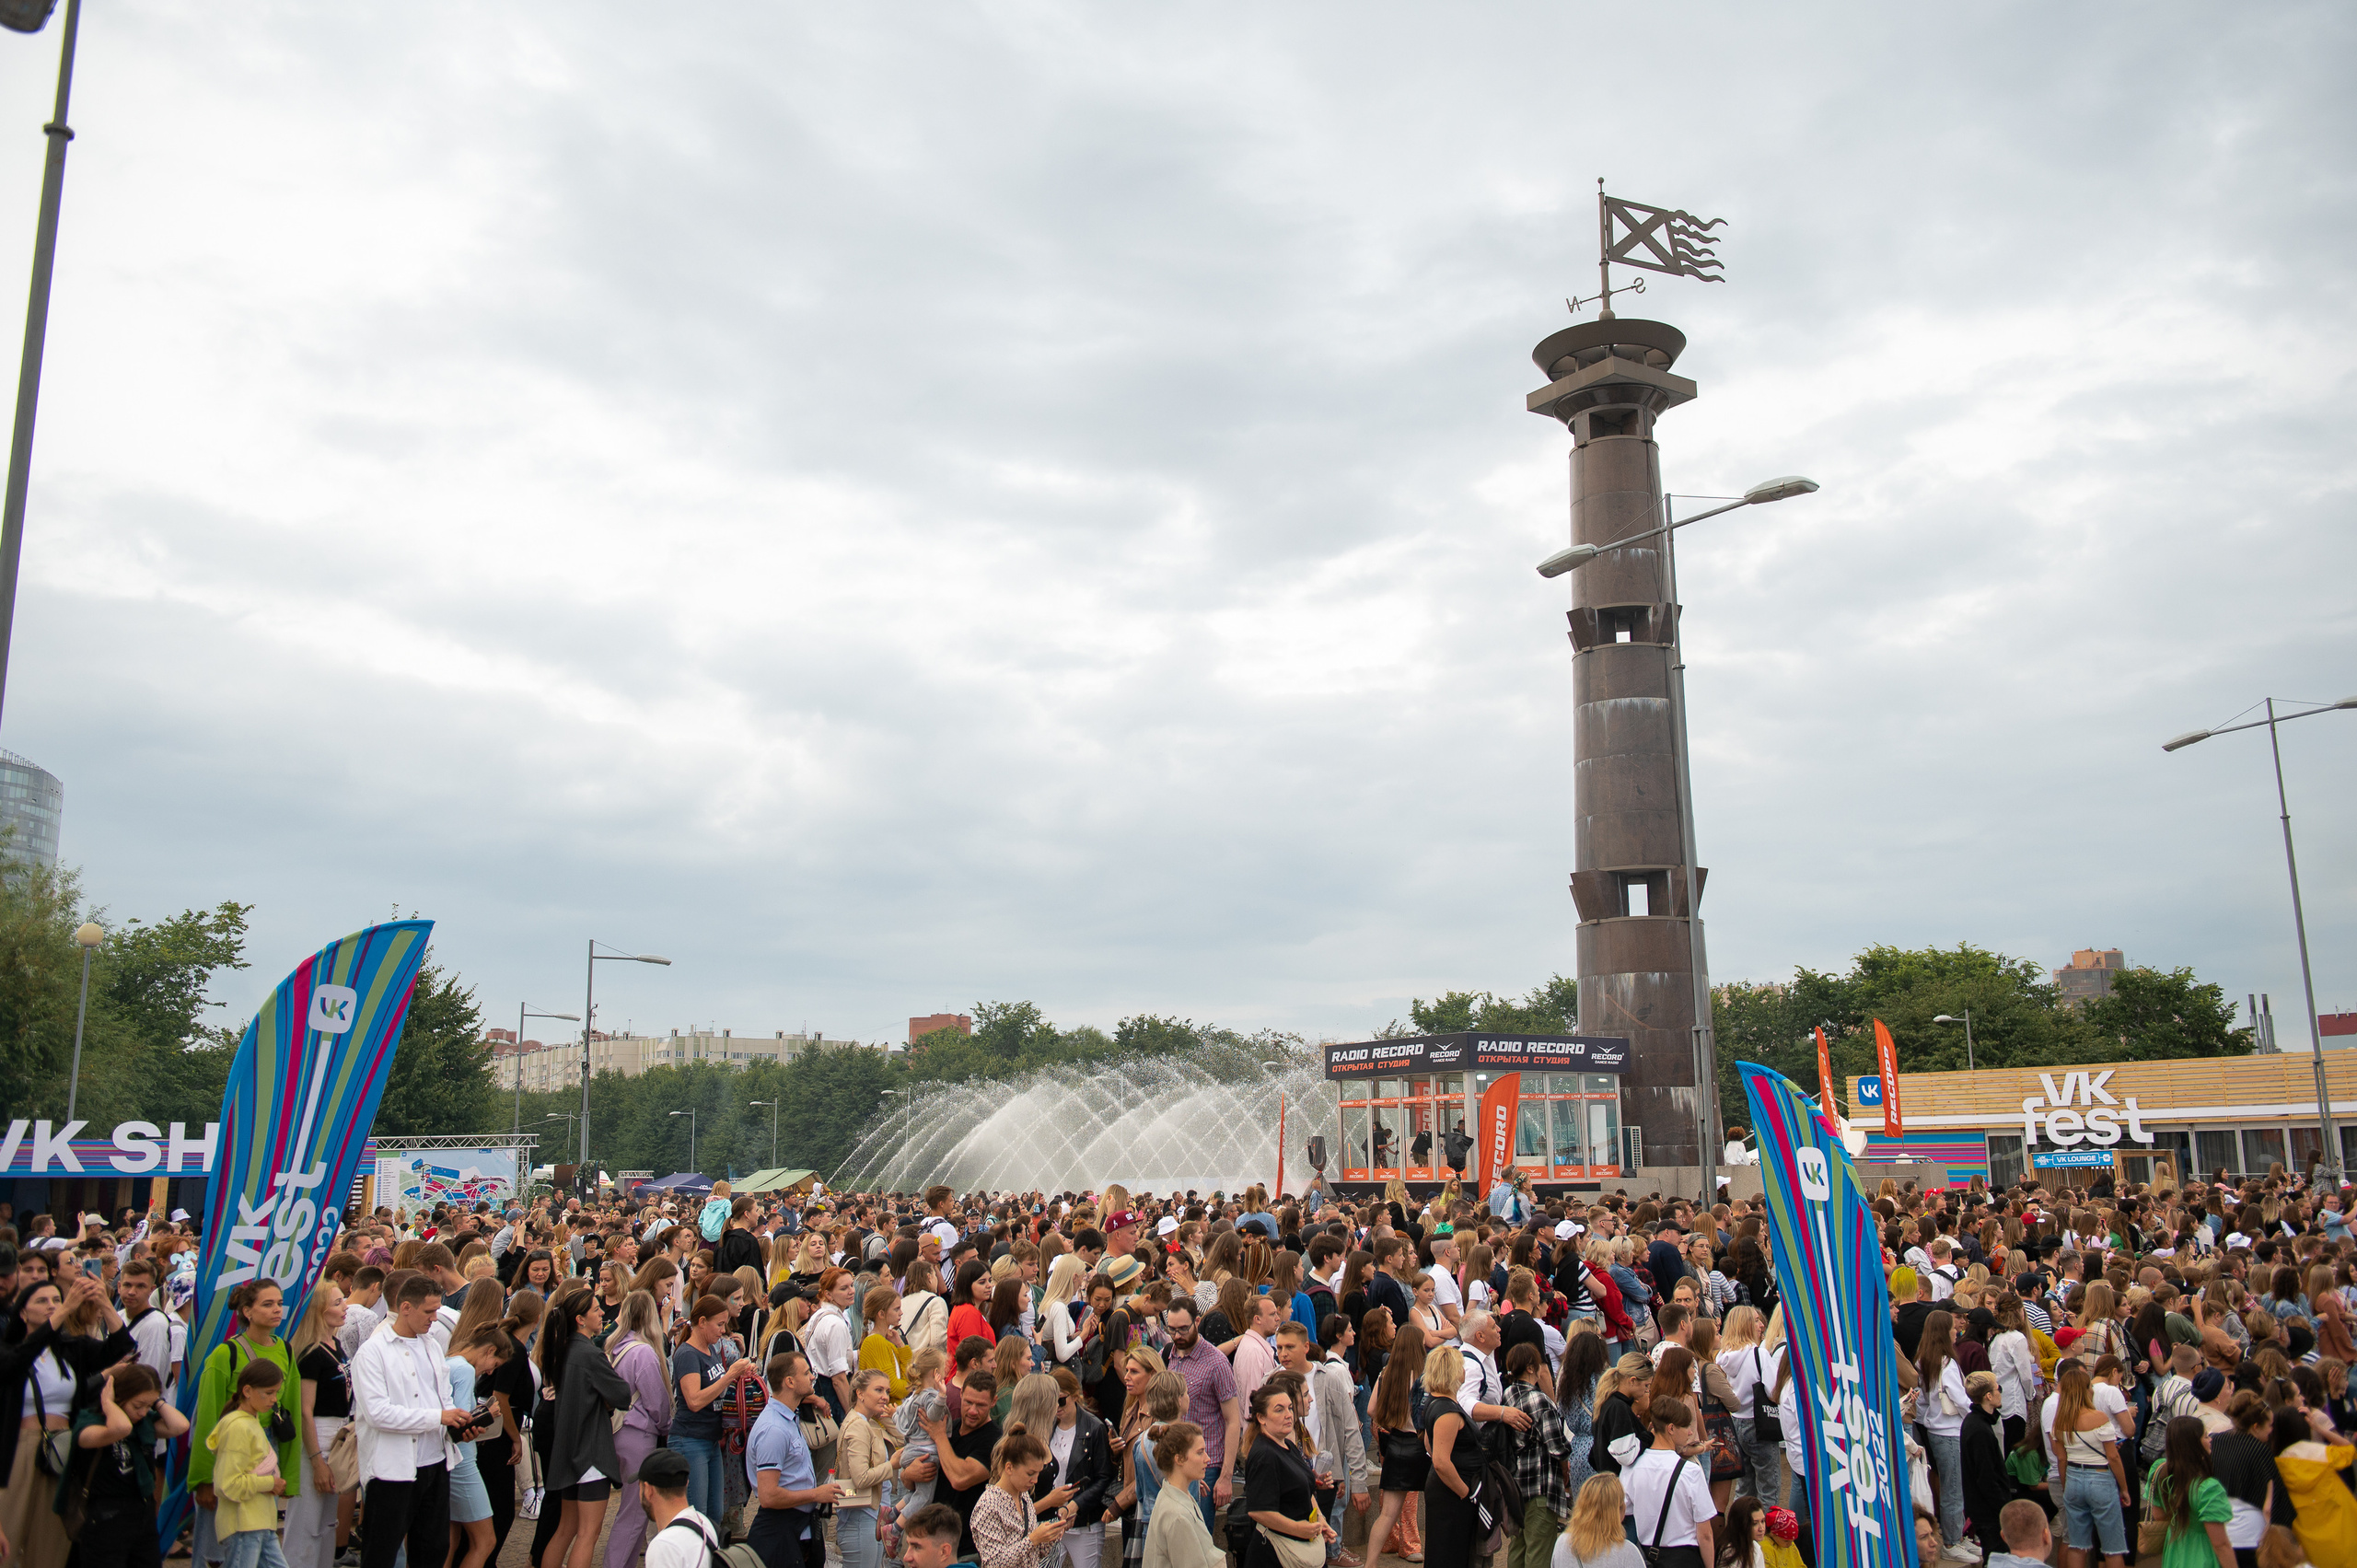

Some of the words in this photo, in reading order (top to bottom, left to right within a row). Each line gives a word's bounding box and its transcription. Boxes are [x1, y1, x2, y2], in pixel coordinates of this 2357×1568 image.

[1331, 1049, 1368, 1063] RADIO
[1372, 1043, 1424, 1059] RECORD
[1332, 1062, 1374, 1073] ОТКРЫТАЯ
[1377, 1059, 1411, 1069] СТУДИЯ
[1429, 1050, 1460, 1059] RECORD
[1477, 1040, 1522, 1052] RADIO
[1527, 1042, 1585, 1054] RECORD
[1478, 1055, 1528, 1063] ОТКРЫТАЯ
[1533, 1056, 1570, 1064] СТУДИЯ
[1862, 1084, 1879, 1098] VK
[2038, 1070, 2119, 1107] VK
[2022, 1097, 2154, 1145] fest
[109, 1121, 220, 1173] SH
[1490, 1105, 1507, 1192] RECORD
[1802, 1162, 1825, 1186] VK
[215, 1192, 279, 1291] VK
[260, 1161, 328, 1296] est
[1817, 1384, 1851, 1493] VK
[1831, 1352, 1882, 1539] fest
[1868, 1409, 1892, 1510] 2022
